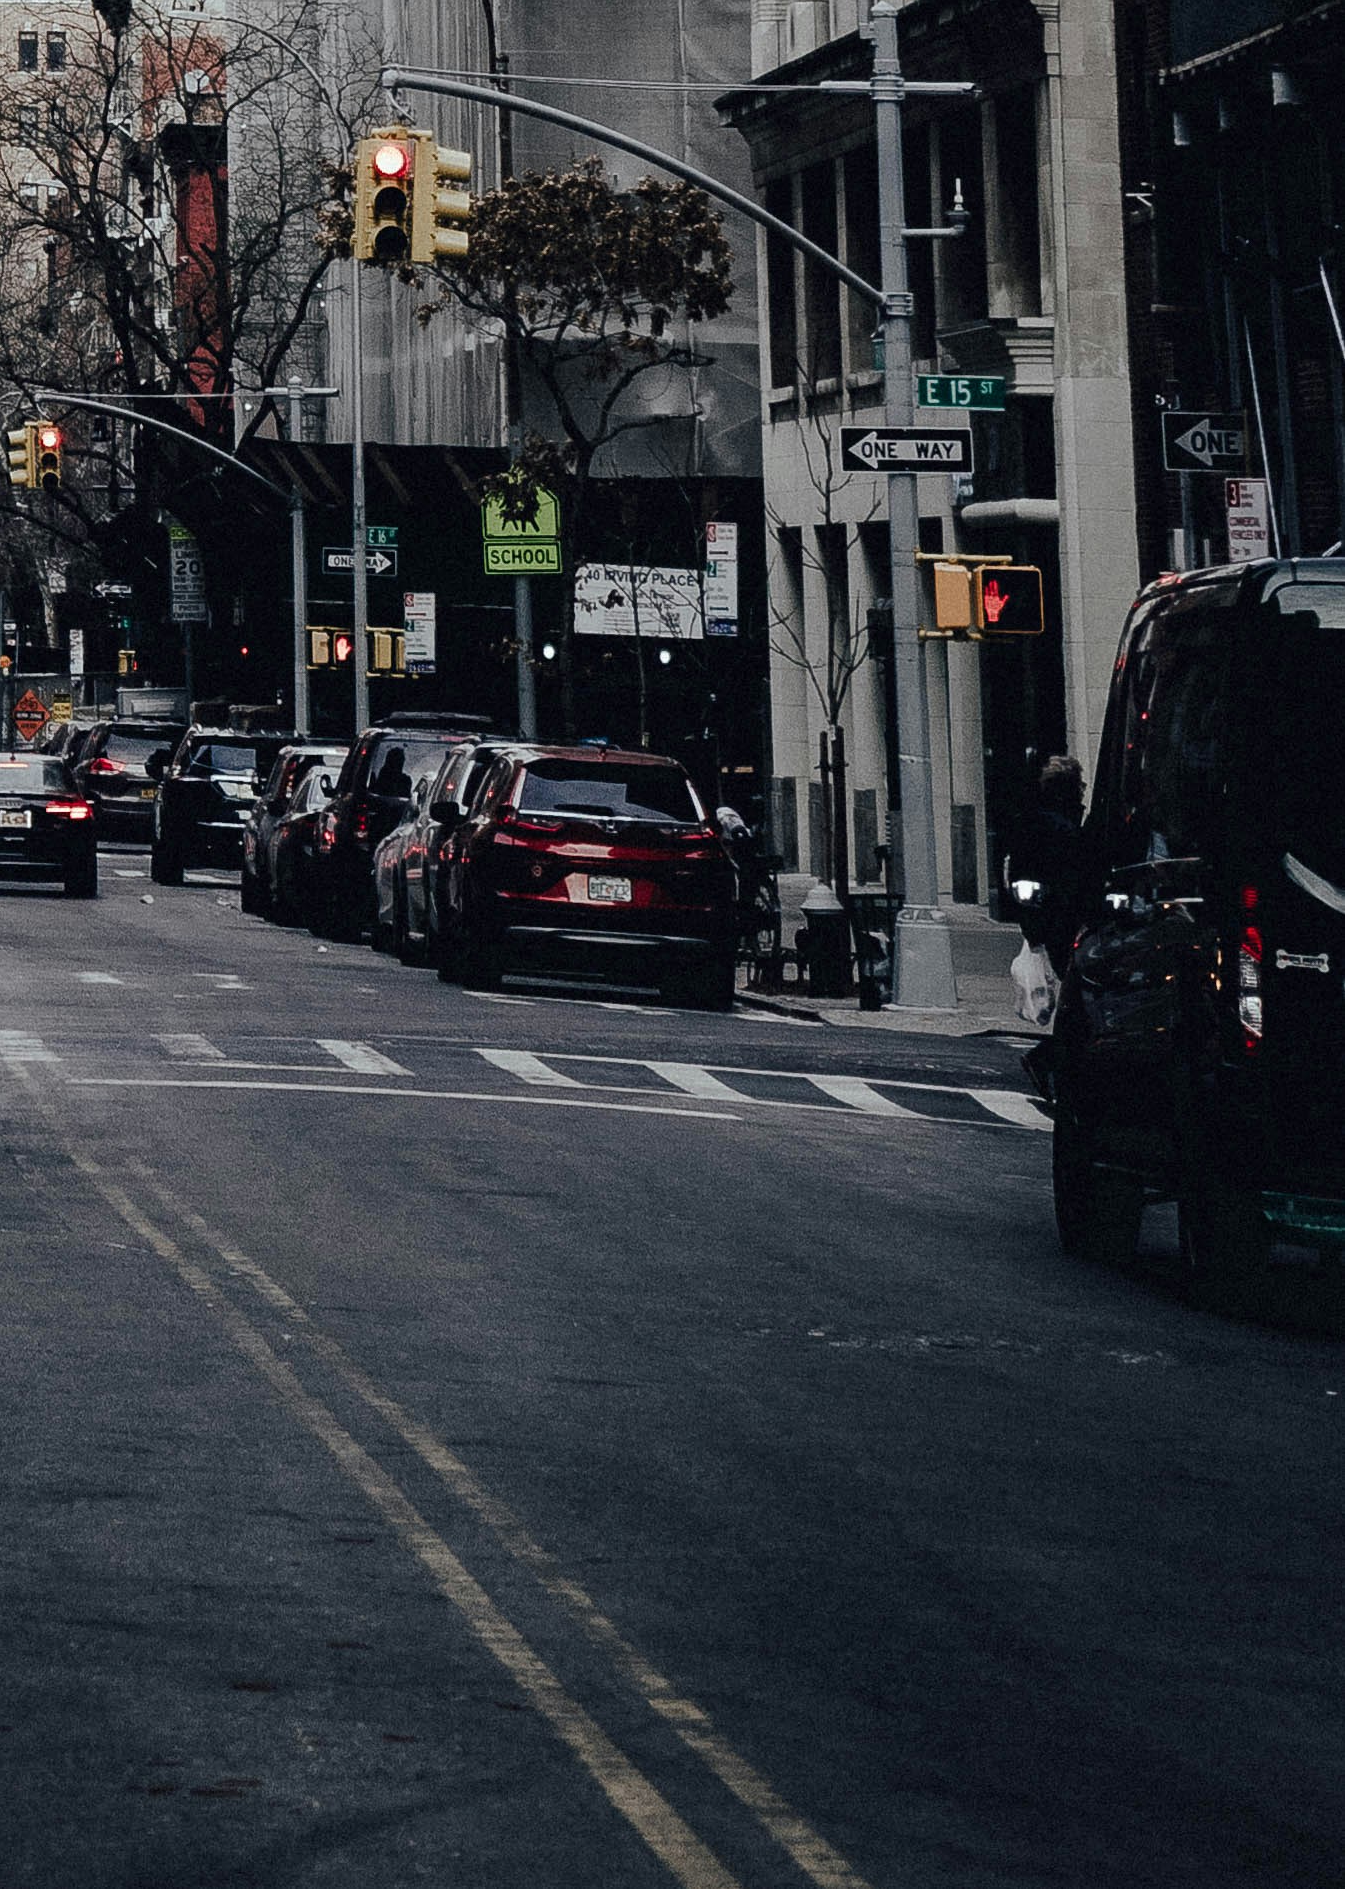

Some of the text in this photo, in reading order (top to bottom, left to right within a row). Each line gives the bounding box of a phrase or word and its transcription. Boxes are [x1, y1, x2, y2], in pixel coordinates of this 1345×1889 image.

[926, 379, 994, 405] E 15 ST
[861, 442, 954, 459] ONE WAY
[1191, 430, 1237, 454] ONE
[1230, 483, 1237, 505] 3
[368, 529, 375, 543] E
[378, 530, 386, 543] 16
[333, 556, 355, 566] ONE
[490, 549, 556, 564] SCHOOL
[175, 560, 200, 575] 20
[605, 570, 648, 584] IRVING
[652, 572, 695, 587] PLACE
